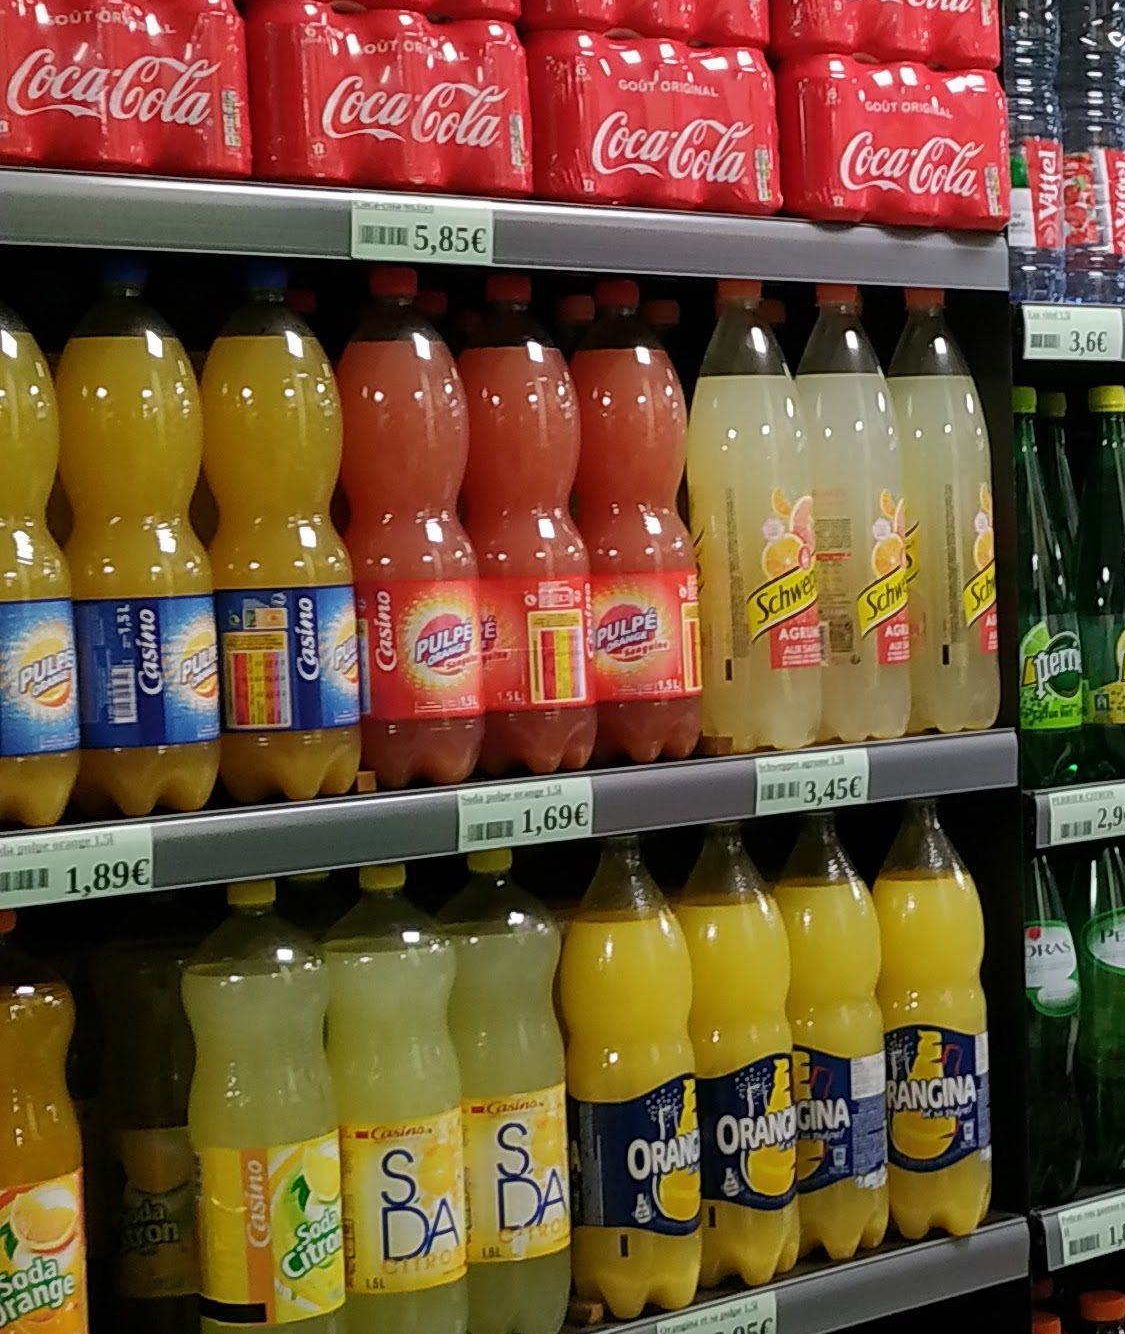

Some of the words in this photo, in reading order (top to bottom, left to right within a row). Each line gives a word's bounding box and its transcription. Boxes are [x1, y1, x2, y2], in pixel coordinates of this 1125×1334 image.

[5, 48, 221, 127] Coca-Cola
[322, 75, 509, 148] Coca-Cola
[618, 77, 657, 93] GOÛT
[660, 79, 720, 99] ORIGINAL
[591, 110, 754, 184] Coca-Cola
[840, 130, 985, 199] Coca-Cola
[1037, 147, 1060, 221] Vittel
[413, 225, 488, 256] 5,85€
[1069, 330, 1108, 354] 3,6€
[138, 608, 163, 696] Casino
[296, 597, 320, 682] Casino
[374, 590, 397, 672] Casino
[415, 620, 473, 664] PULPÉ
[596, 608, 659, 650] PULPÉ
[803, 776, 862, 805] 3,45€
[522, 802, 589, 837] 1,69€
[65, 858, 150, 897] 1,89€
[370, 1123, 426, 1141] Casino
[485, 1098, 539, 1116] Casino
[246, 1159, 271, 1249] Casino
[497, 1167, 568, 1229] DA
[295, 1207, 339, 1247] Soda
[381, 1197, 460, 1261] DA
